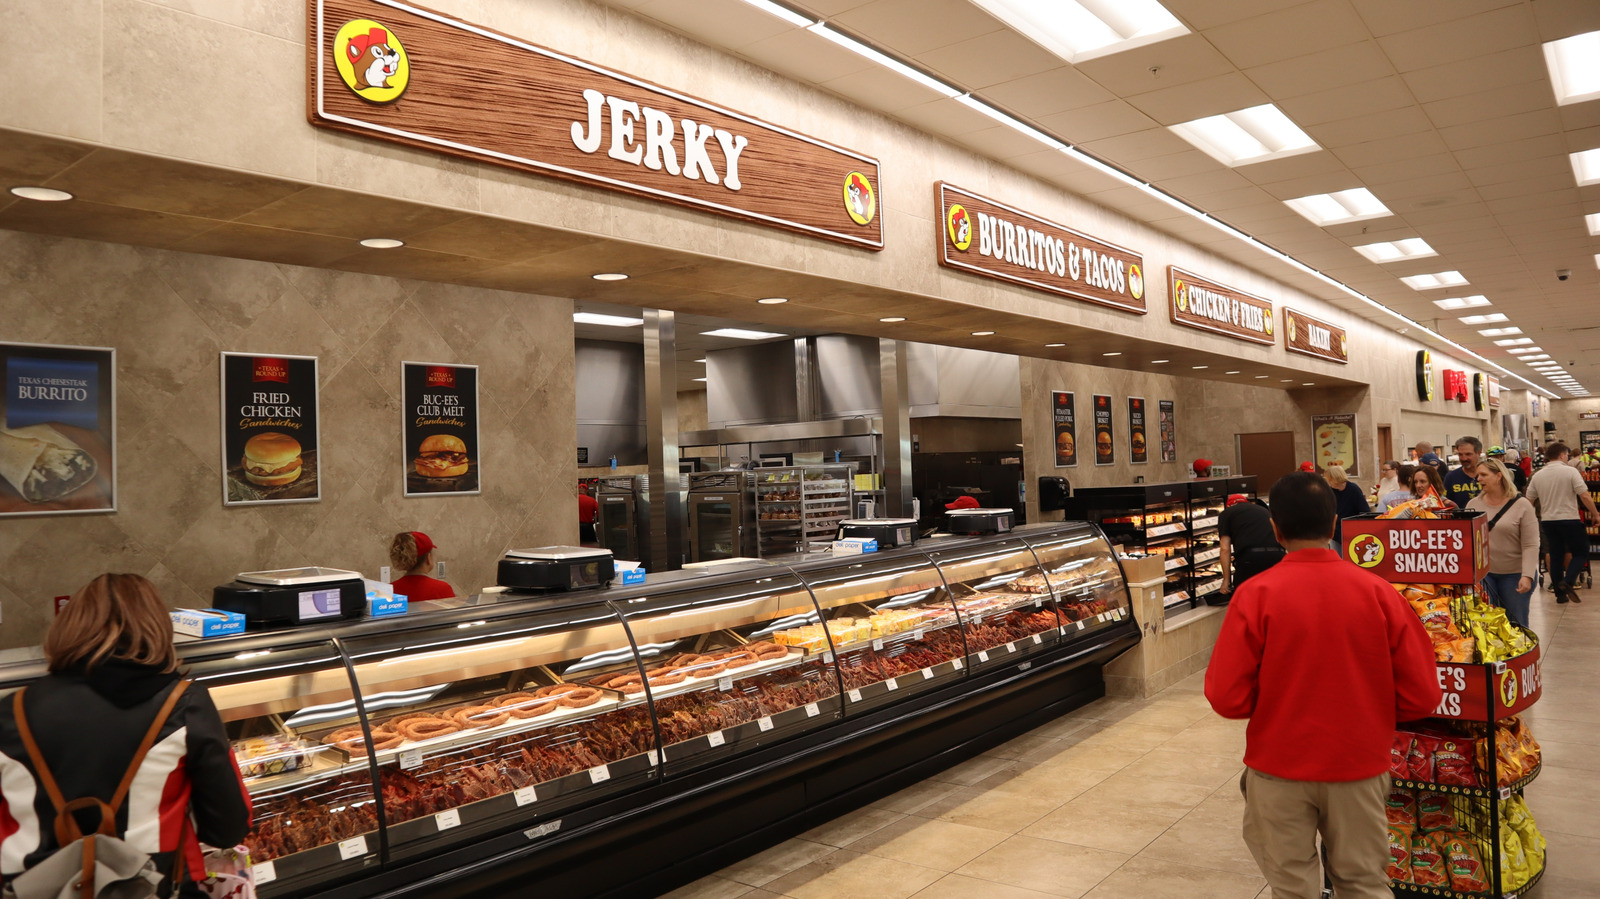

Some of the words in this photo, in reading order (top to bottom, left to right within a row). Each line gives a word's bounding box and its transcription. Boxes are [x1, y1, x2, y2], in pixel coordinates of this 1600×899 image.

[570, 88, 749, 191] JERKY
[977, 211, 1066, 278] BURRITOS
[1068, 241, 1080, 281] &
[1082, 247, 1125, 295] TACOS
[1188, 284, 1231, 324] CHICKEN
[1232, 299, 1239, 326] &
[1240, 301, 1264, 333] FRIES
[1307, 323, 1331, 351] BAKERY
[18, 376, 41, 384] TEXAS
[42, 377, 87, 387] CHEESESTEAK
[18, 385, 87, 402] BURRITO
[253, 392, 290, 404] FRIED
[423, 394, 459, 406] BUC-EE'S
[240, 405, 301, 418] CHICKEN
[416, 405, 441, 416] CLUB
[442, 406, 465, 417] MELT
[239, 417, 303, 430] Sandwiches
[415, 416, 467, 428] Sandwiches
[1389, 529, 1463, 550] BUC-EE'S
[1394, 552, 1459, 574] SNACKS
[388, 602, 403, 610] paper
[210, 623, 221, 631] deli
[222, 621, 240, 631] paper
